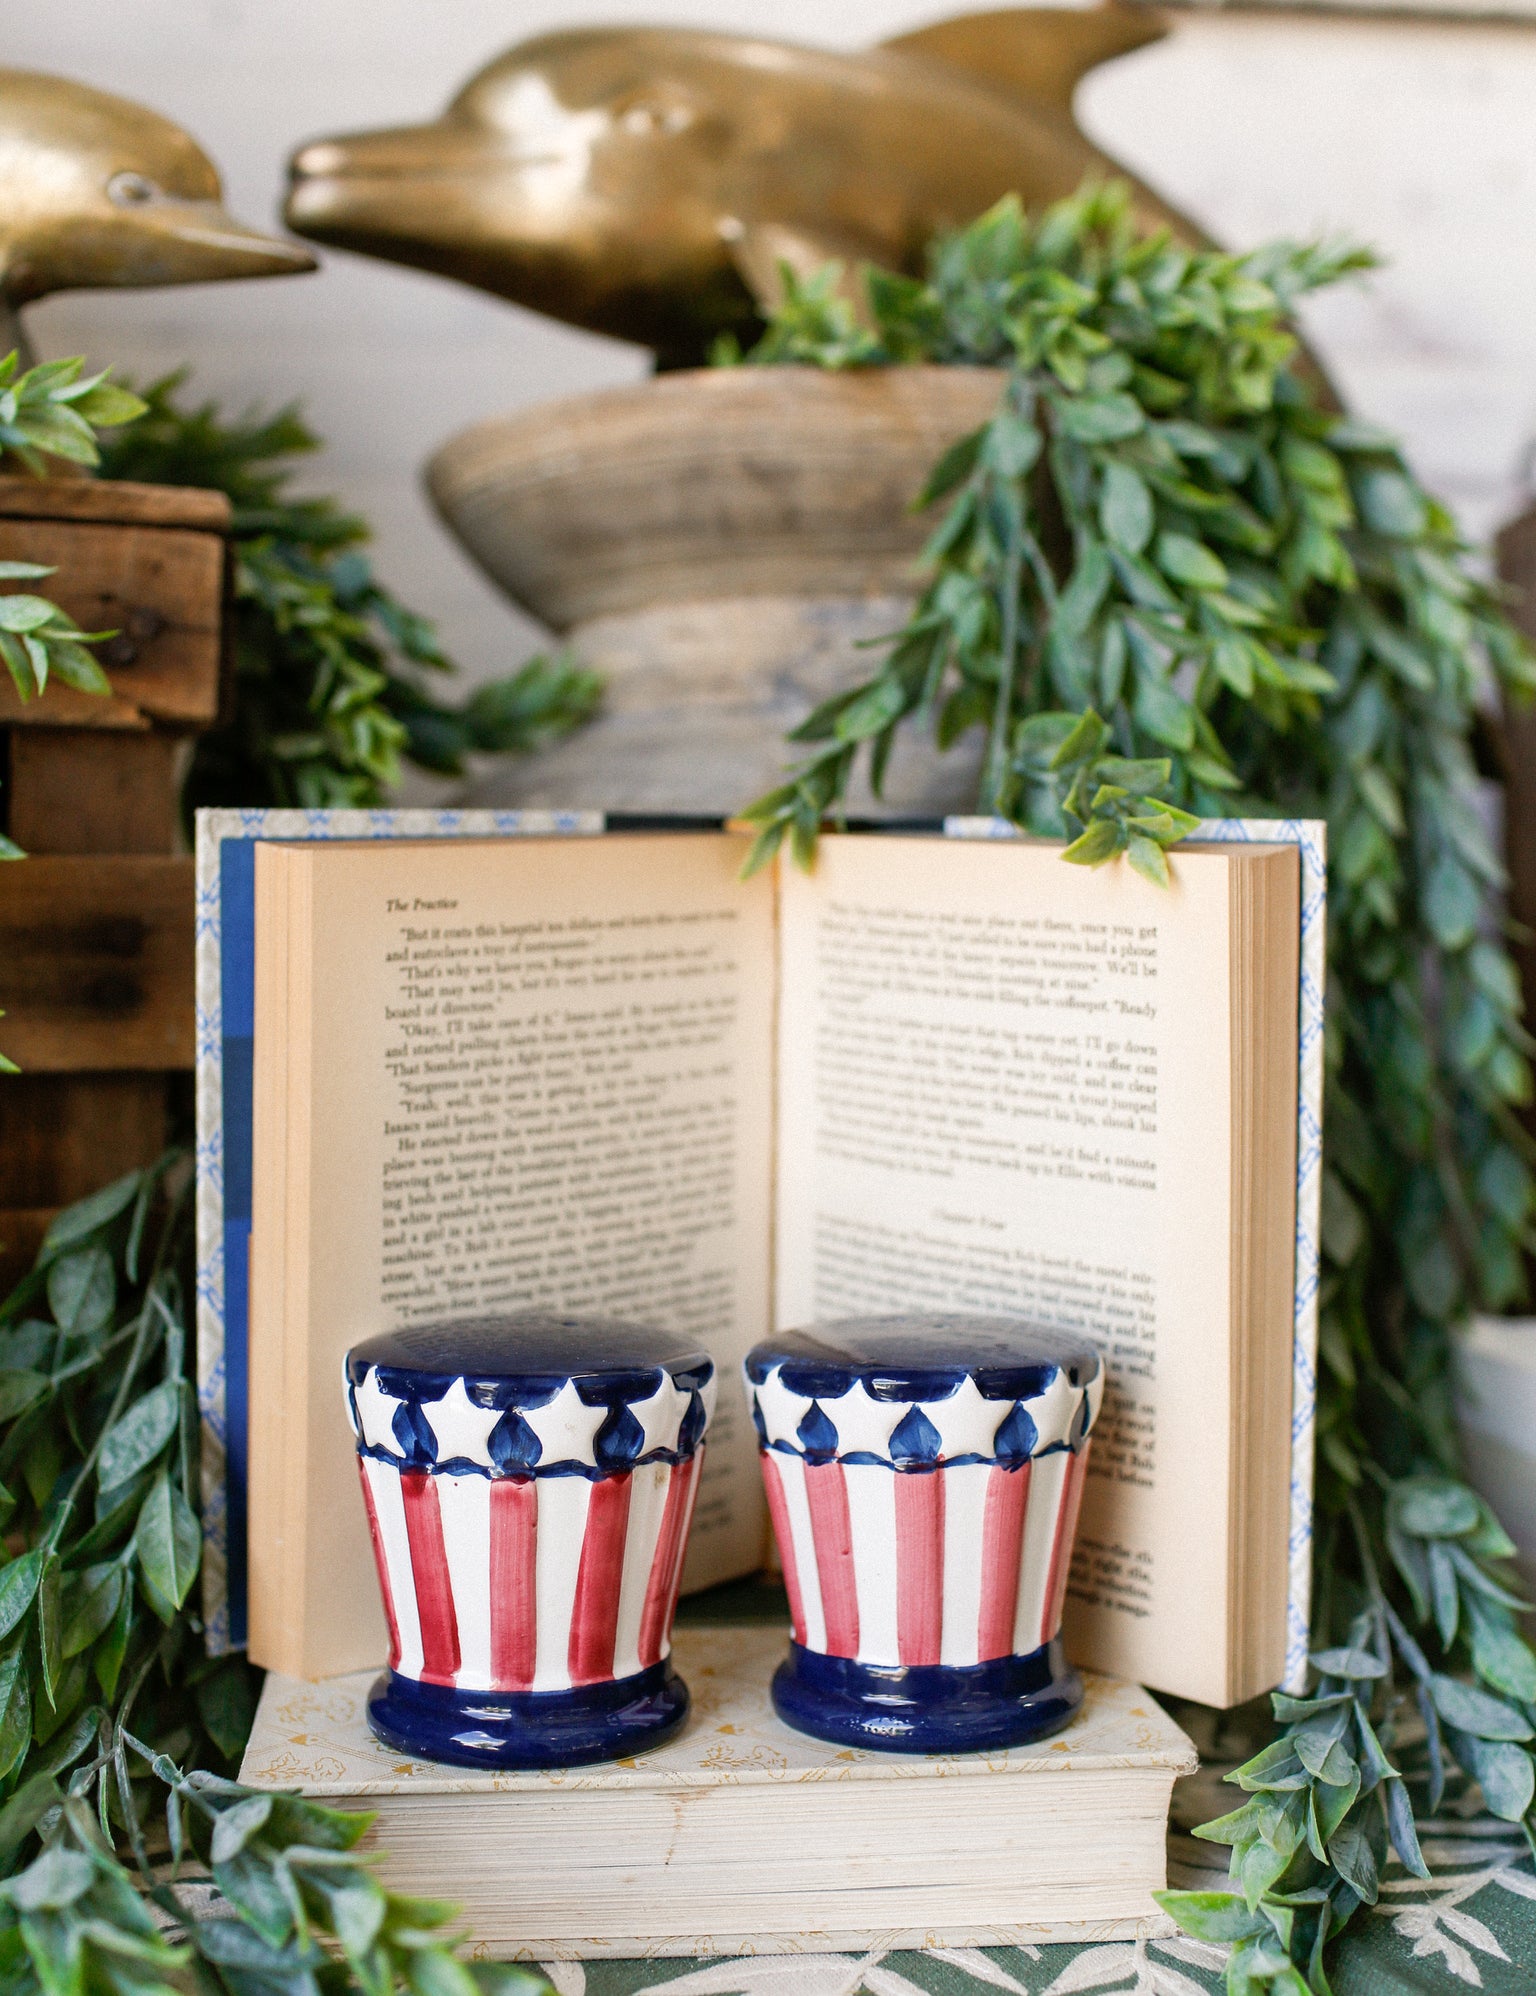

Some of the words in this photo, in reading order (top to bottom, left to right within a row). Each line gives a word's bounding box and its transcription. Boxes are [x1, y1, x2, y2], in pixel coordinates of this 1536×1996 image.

[386, 899, 409, 912] The
[413, 898, 458, 911] Practice
[476, 925, 496, 937] this
[1113, 925, 1134, 938] you
[386, 948, 408, 962] and
[413, 946, 469, 960] autoclave
[1121, 943, 1157, 958] phone
[446, 963, 470, 979] why
[1143, 963, 1158, 976] be
[439, 986, 463, 999] may
[470, 978, 495, 993] well
[385, 1004, 421, 1020] board
[425, 1001, 438, 1015] of
[468, 1020, 492, 1031] take
[498, 1019, 521, 1028] care
[385, 1043, 408, 1057] and
[413, 1040, 454, 1054] started
[459, 1038, 500, 1054] pulling
[1106, 1041, 1120, 1053] go
[1124, 1039, 1157, 1056] down
[1097, 1056, 1131, 1073] coffee
[1137, 1063, 1157, 1075] can
[1085, 1074, 1106, 1088] and
[1128, 1079, 1157, 1094] clear
[1112, 1096, 1157, 1115] jumped
[425, 1115, 449, 1130] said
[1102, 1114, 1134, 1131] shook
[1140, 1116, 1157, 1133] his
[399, 1137, 416, 1150] He
[421, 1132, 461, 1148] started
[467, 1131, 498, 1142] down
[503, 1126, 520, 1138] the
[383, 1158, 416, 1176] place
[421, 1157, 444, 1166] was
[434, 1171, 452, 1183] the
[456, 1168, 477, 1181] last
[481, 1167, 492, 1177] of
[498, 1165, 513, 1175] the
[1088, 1171, 1113, 1183] with
[383, 1198, 402, 1211] ing
[441, 1187, 463, 1201] and
[469, 1185, 512, 1200] helping
[383, 1217, 395, 1228] in
[400, 1212, 431, 1225] white
[383, 1232, 406, 1247] and
[424, 1228, 445, 1243] girl
